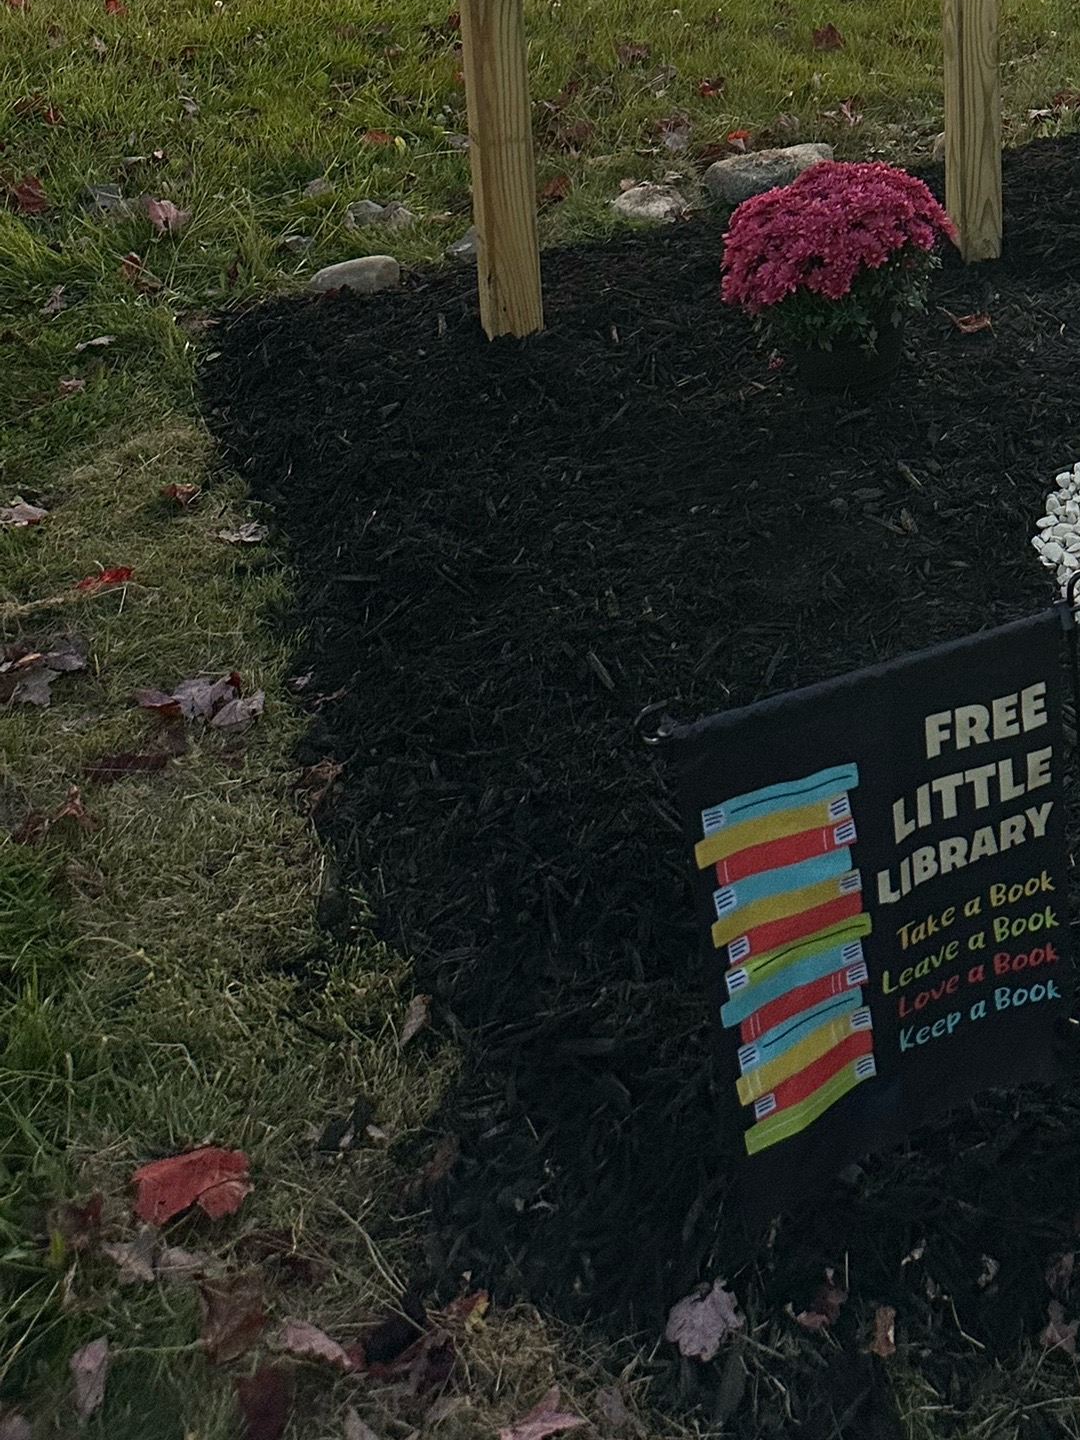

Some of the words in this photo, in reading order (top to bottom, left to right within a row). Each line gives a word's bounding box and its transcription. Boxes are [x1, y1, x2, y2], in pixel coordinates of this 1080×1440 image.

[925, 681, 1048, 759] FREE
[892, 746, 1053, 844] LITTLE
[877, 801, 1054, 904] LIBRARY
[882, 940, 960, 995] Leave
[968, 931, 986, 951] a
[993, 905, 1060, 943] Book
[895, 906, 956, 950] Take
[963, 896, 982, 917] a
[989, 870, 1056, 907] Book
[898, 974, 960, 1018] Love
[967, 964, 985, 983] a
[993, 942, 1060, 976] Book
[900, 1011, 962, 1052] Keep
[970, 1000, 987, 1021] a
[994, 979, 1062, 1011] Book
